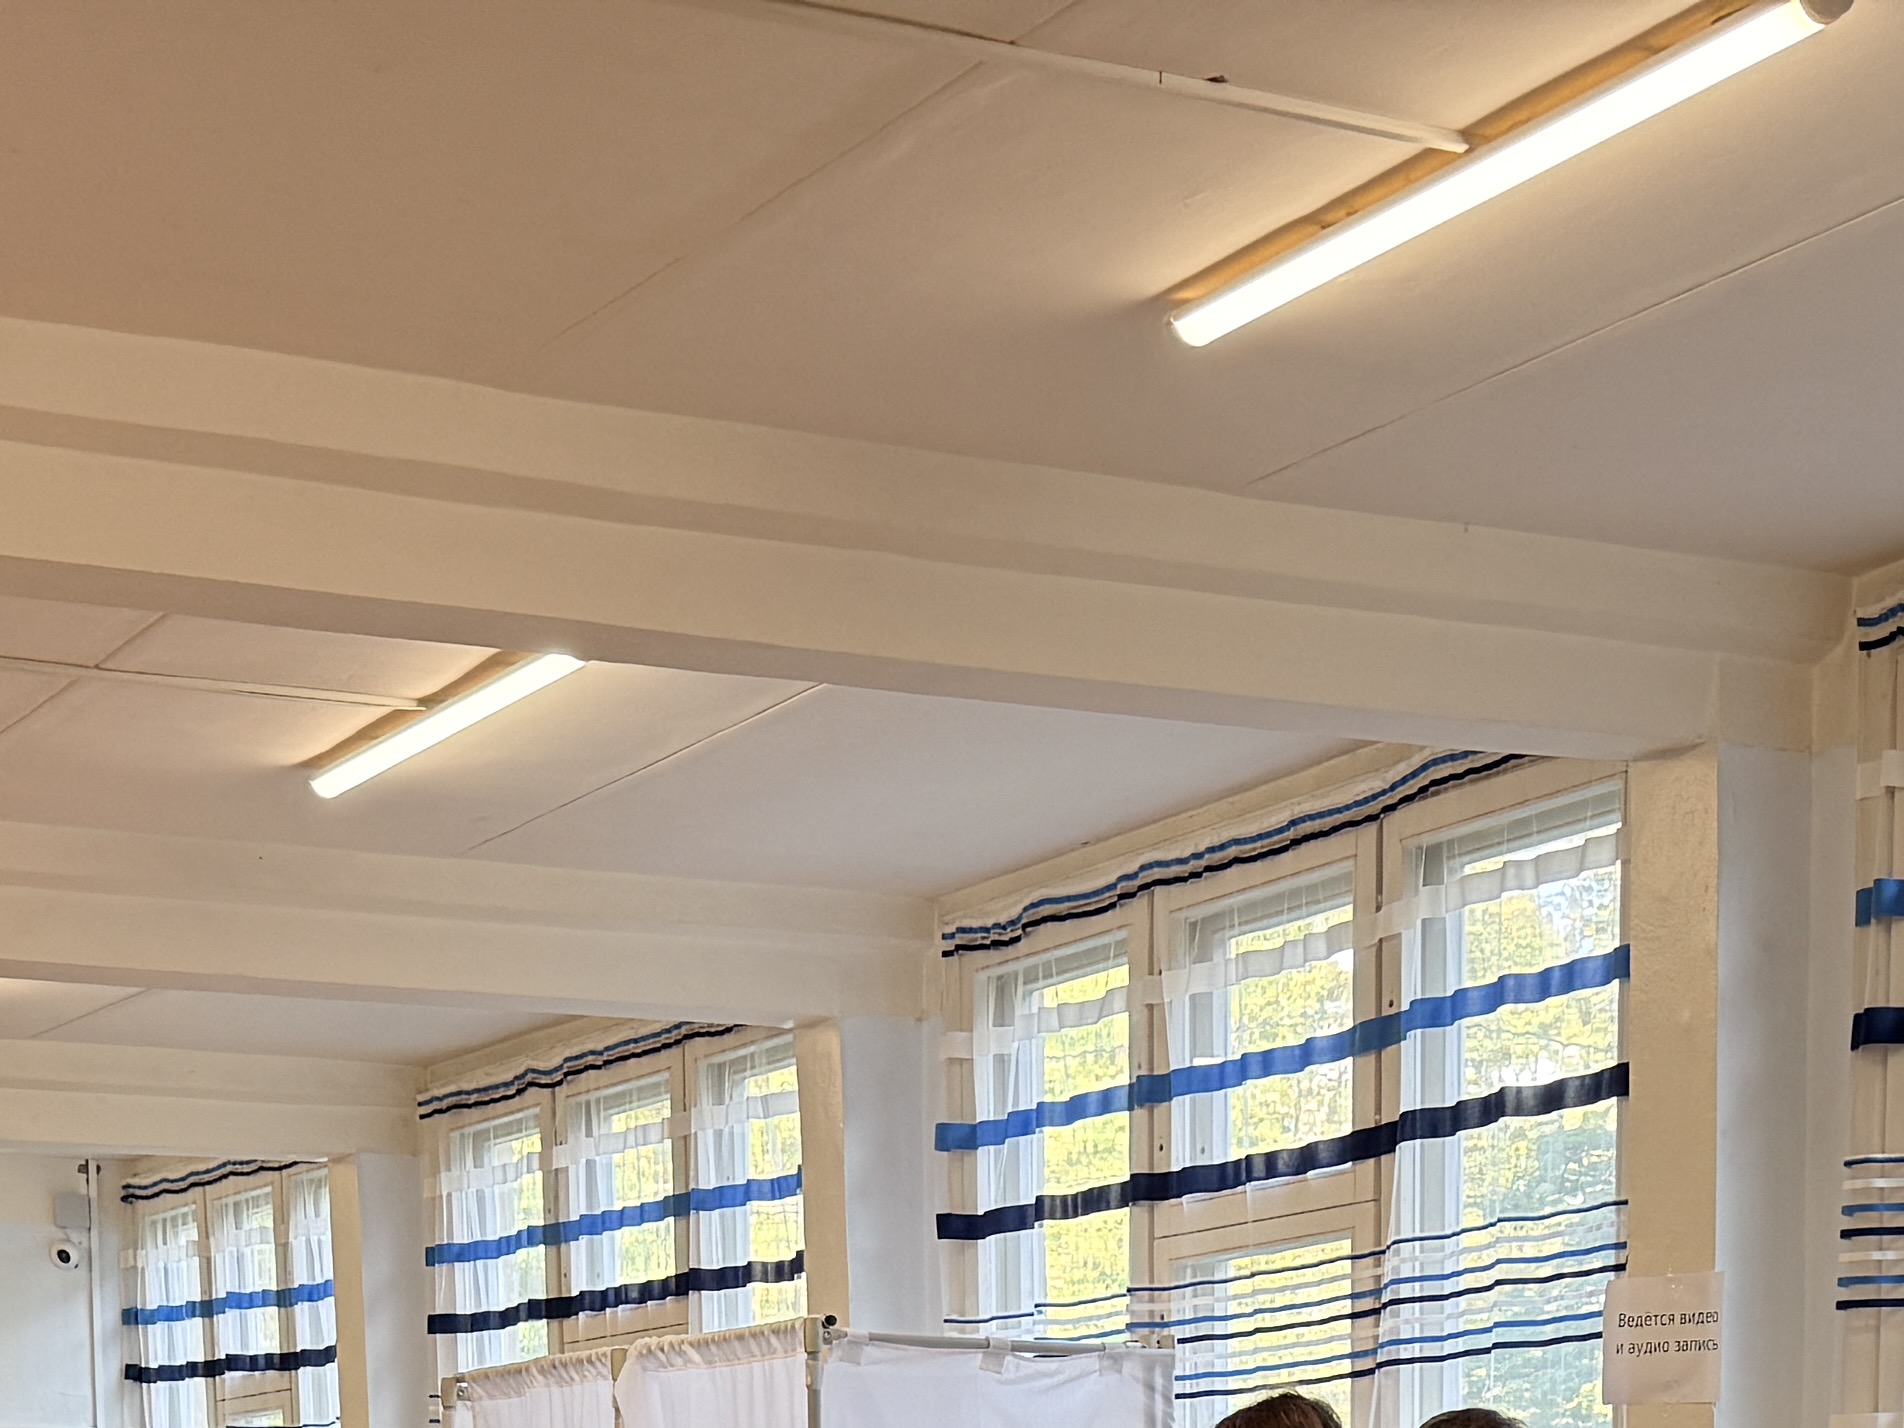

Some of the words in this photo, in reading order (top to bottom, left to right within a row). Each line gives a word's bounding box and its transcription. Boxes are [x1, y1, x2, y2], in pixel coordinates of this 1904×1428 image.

[1618, 1312, 1675, 1329] Ведётся
[1679, 1311, 1719, 1326] видео
[1616, 1342, 1624, 1355] и
[1627, 1340, 1670, 1358] аудио
[1674, 1339, 1719, 1352] запись
